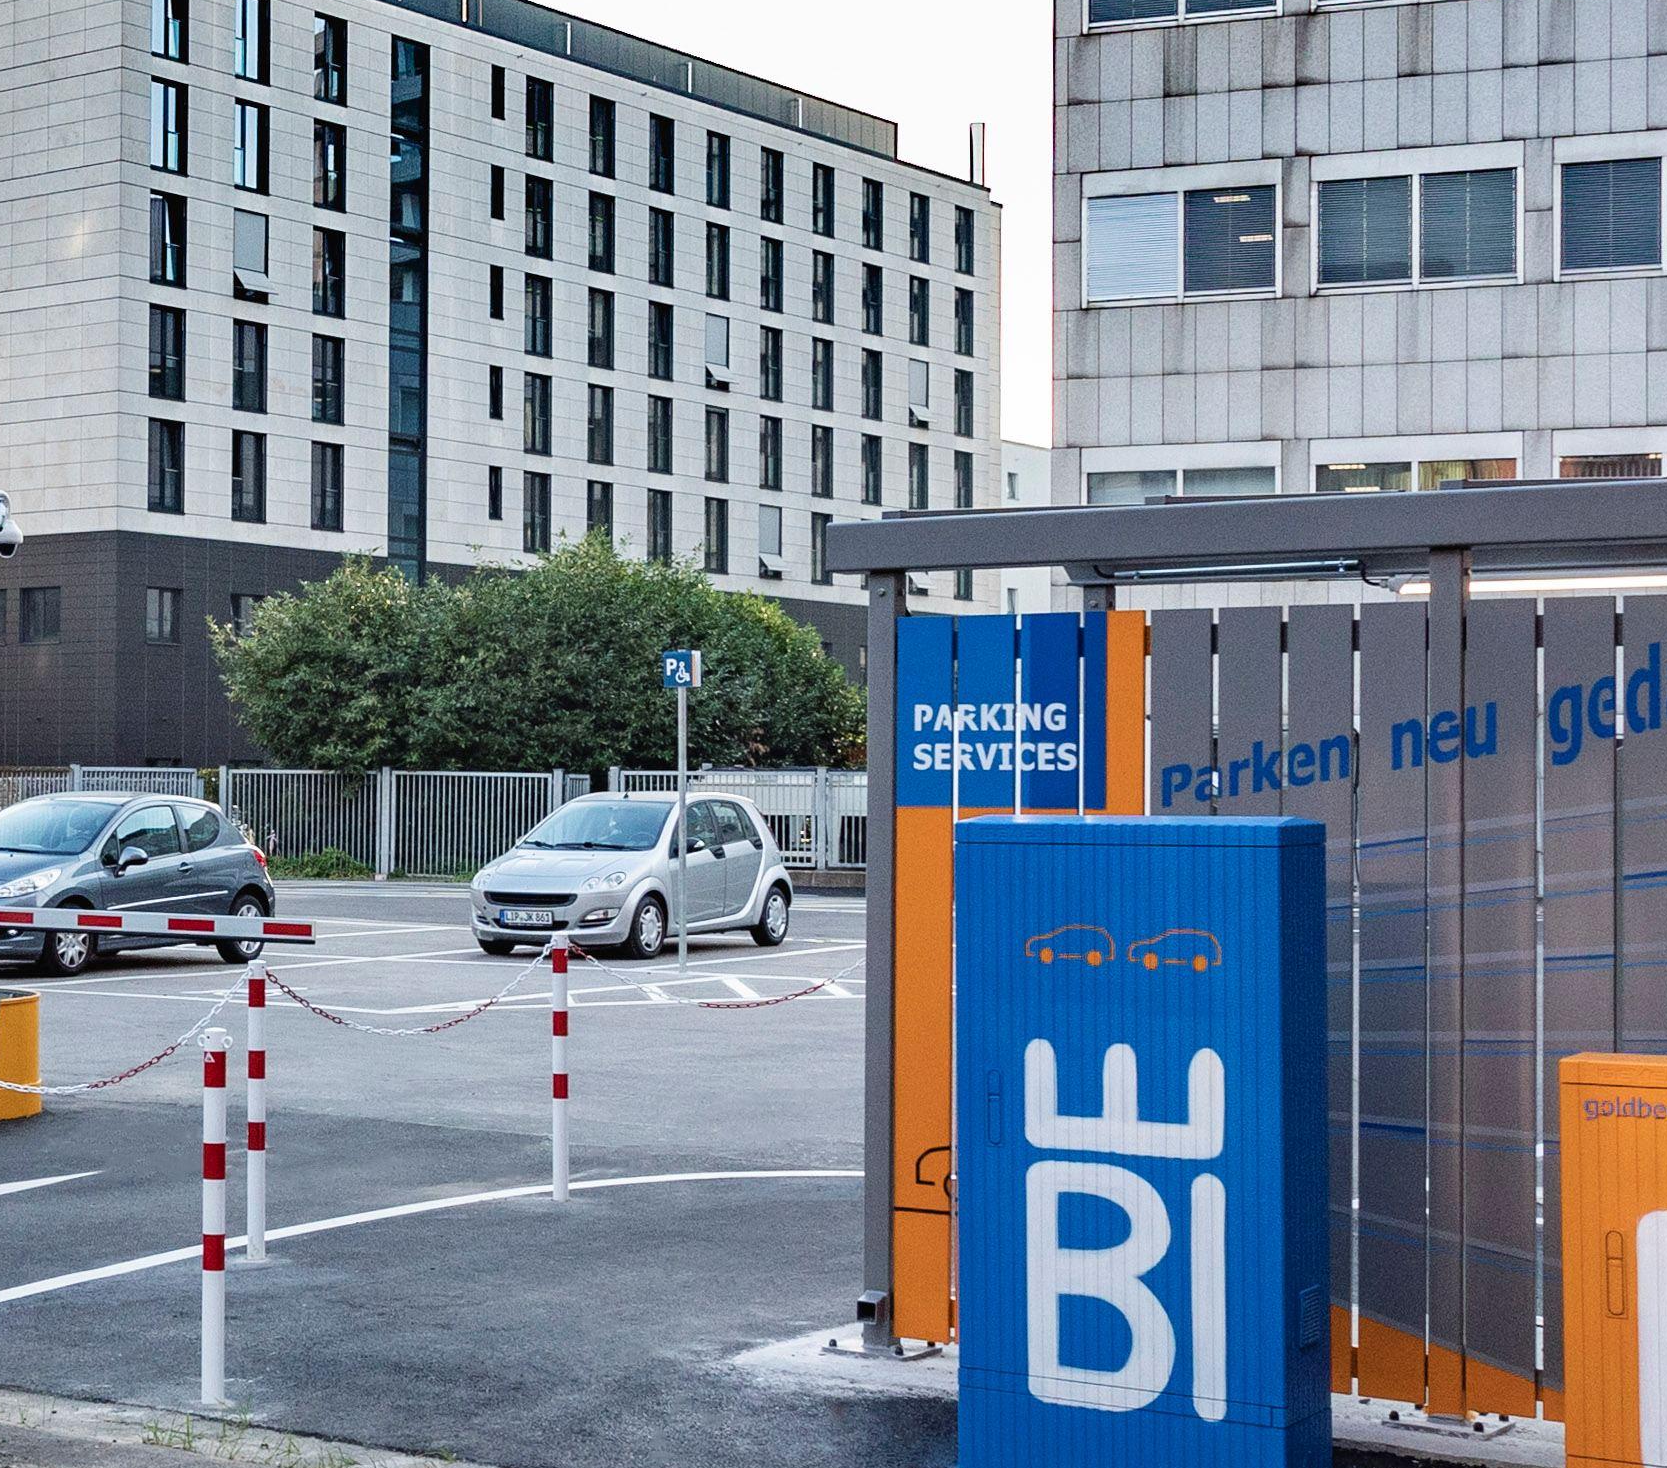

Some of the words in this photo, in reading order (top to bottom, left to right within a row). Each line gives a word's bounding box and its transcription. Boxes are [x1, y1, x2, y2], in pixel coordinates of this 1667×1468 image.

[666, 658, 678, 676] P
[914, 703, 1067, 732] PARKING
[912, 743, 1079, 771] SERVICES
[1161, 732, 1352, 808] Parken
[1391, 702, 1498, 771] neu
